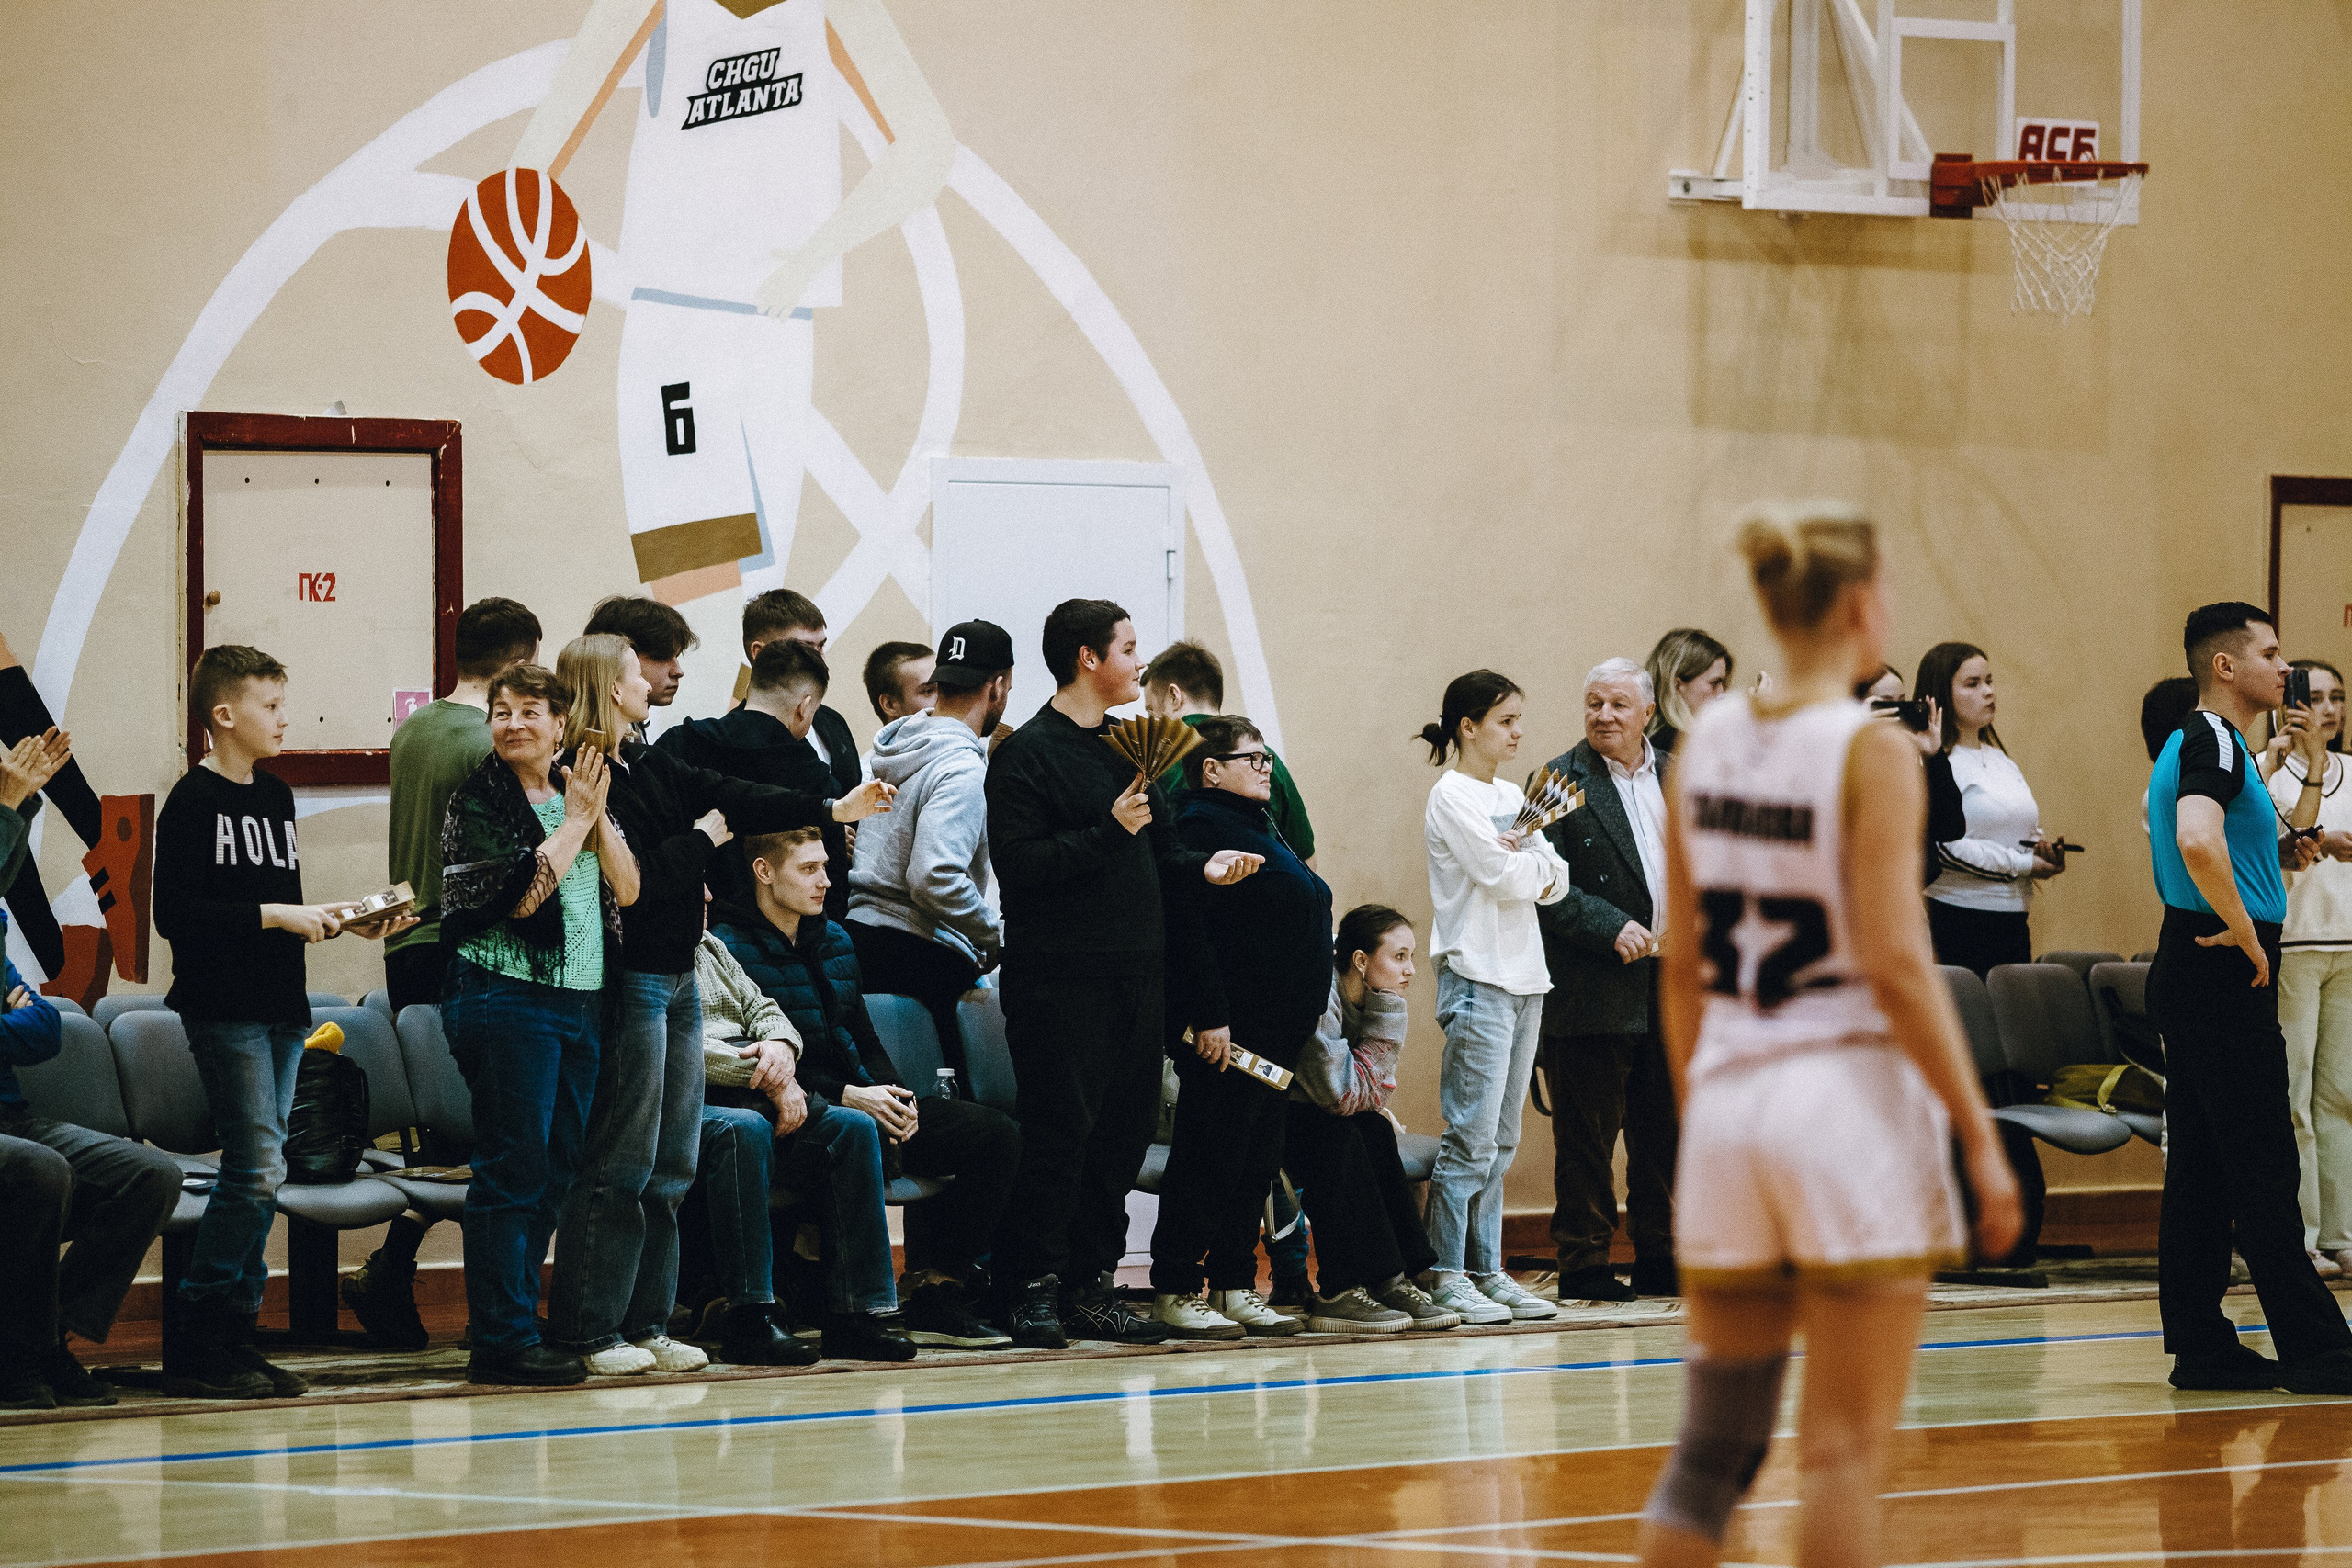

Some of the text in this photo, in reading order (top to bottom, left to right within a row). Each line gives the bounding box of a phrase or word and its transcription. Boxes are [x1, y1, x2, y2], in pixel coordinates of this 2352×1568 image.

[707, 51, 779, 90] CHGU
[687, 77, 800, 125] ATLANTA
[947, 636, 966, 660] D
